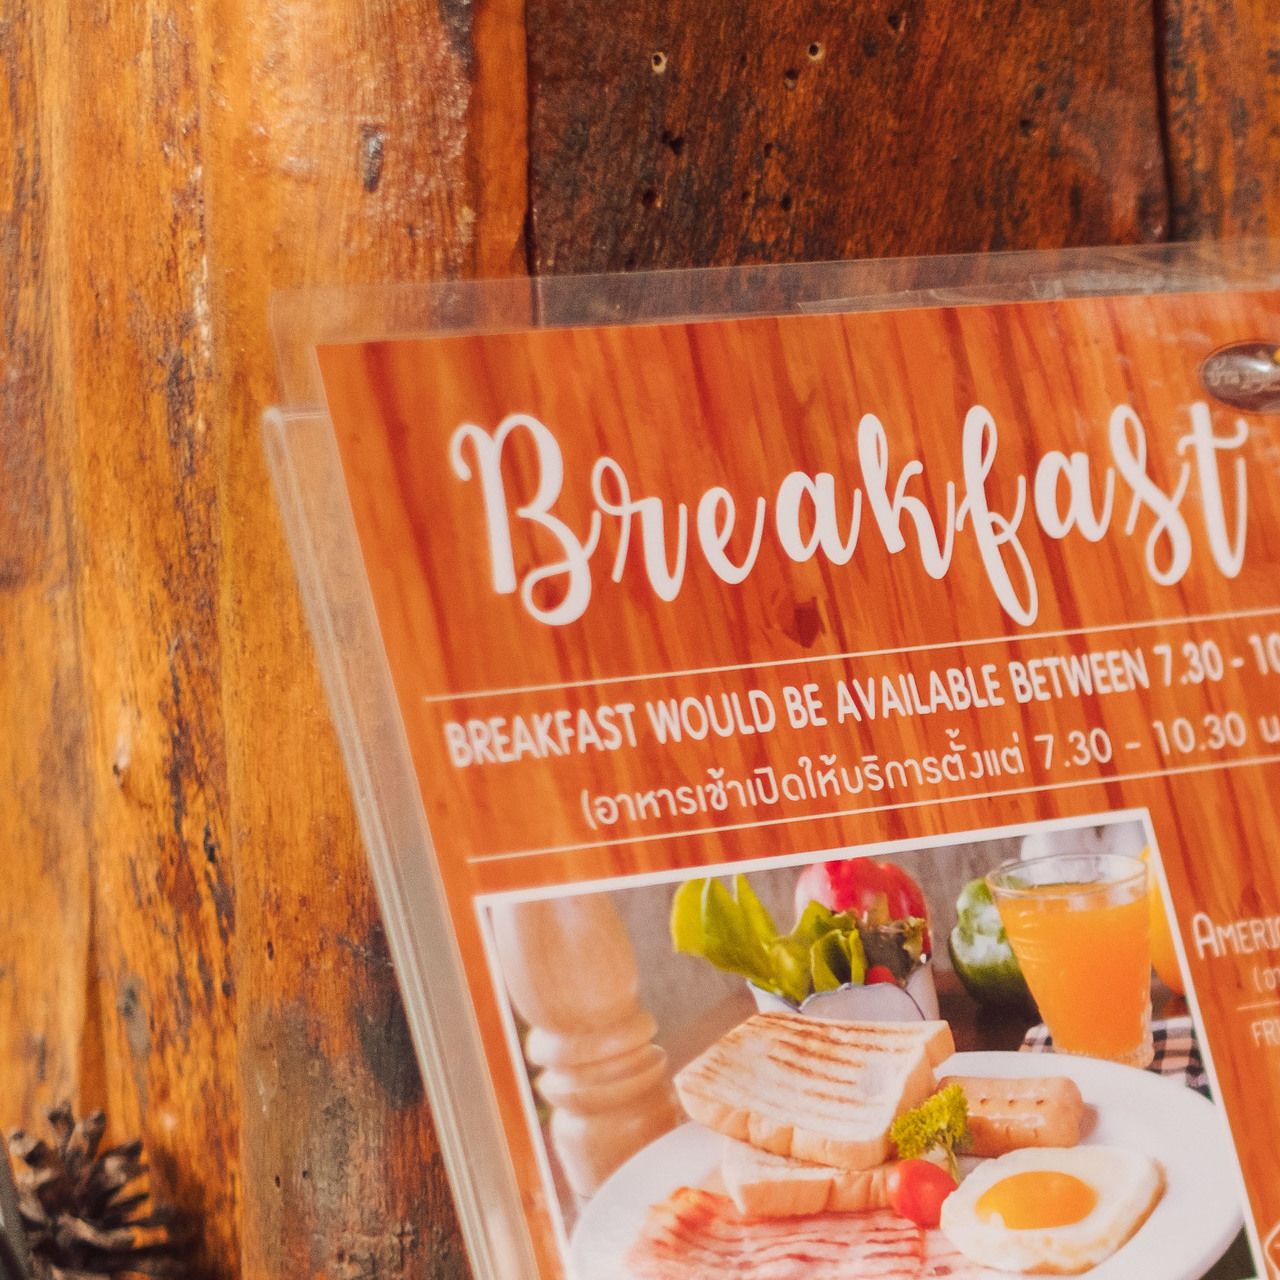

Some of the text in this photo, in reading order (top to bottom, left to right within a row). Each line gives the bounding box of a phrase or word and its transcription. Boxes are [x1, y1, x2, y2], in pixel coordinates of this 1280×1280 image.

[449, 402, 1249, 627] Breakfast
[443, 703, 638, 770] BREAKFAST
[646, 688, 776, 746] WOULD
[783, 683, 827, 730] BE
[836, 663, 1006, 724] AVAILABLE
[1009, 647, 1149, 704] BETWEEN
[1153, 639, 1225, 688] 7.30
[1034, 726, 1113, 771] 7.30
[1152, 711, 1247, 757] 10.30
